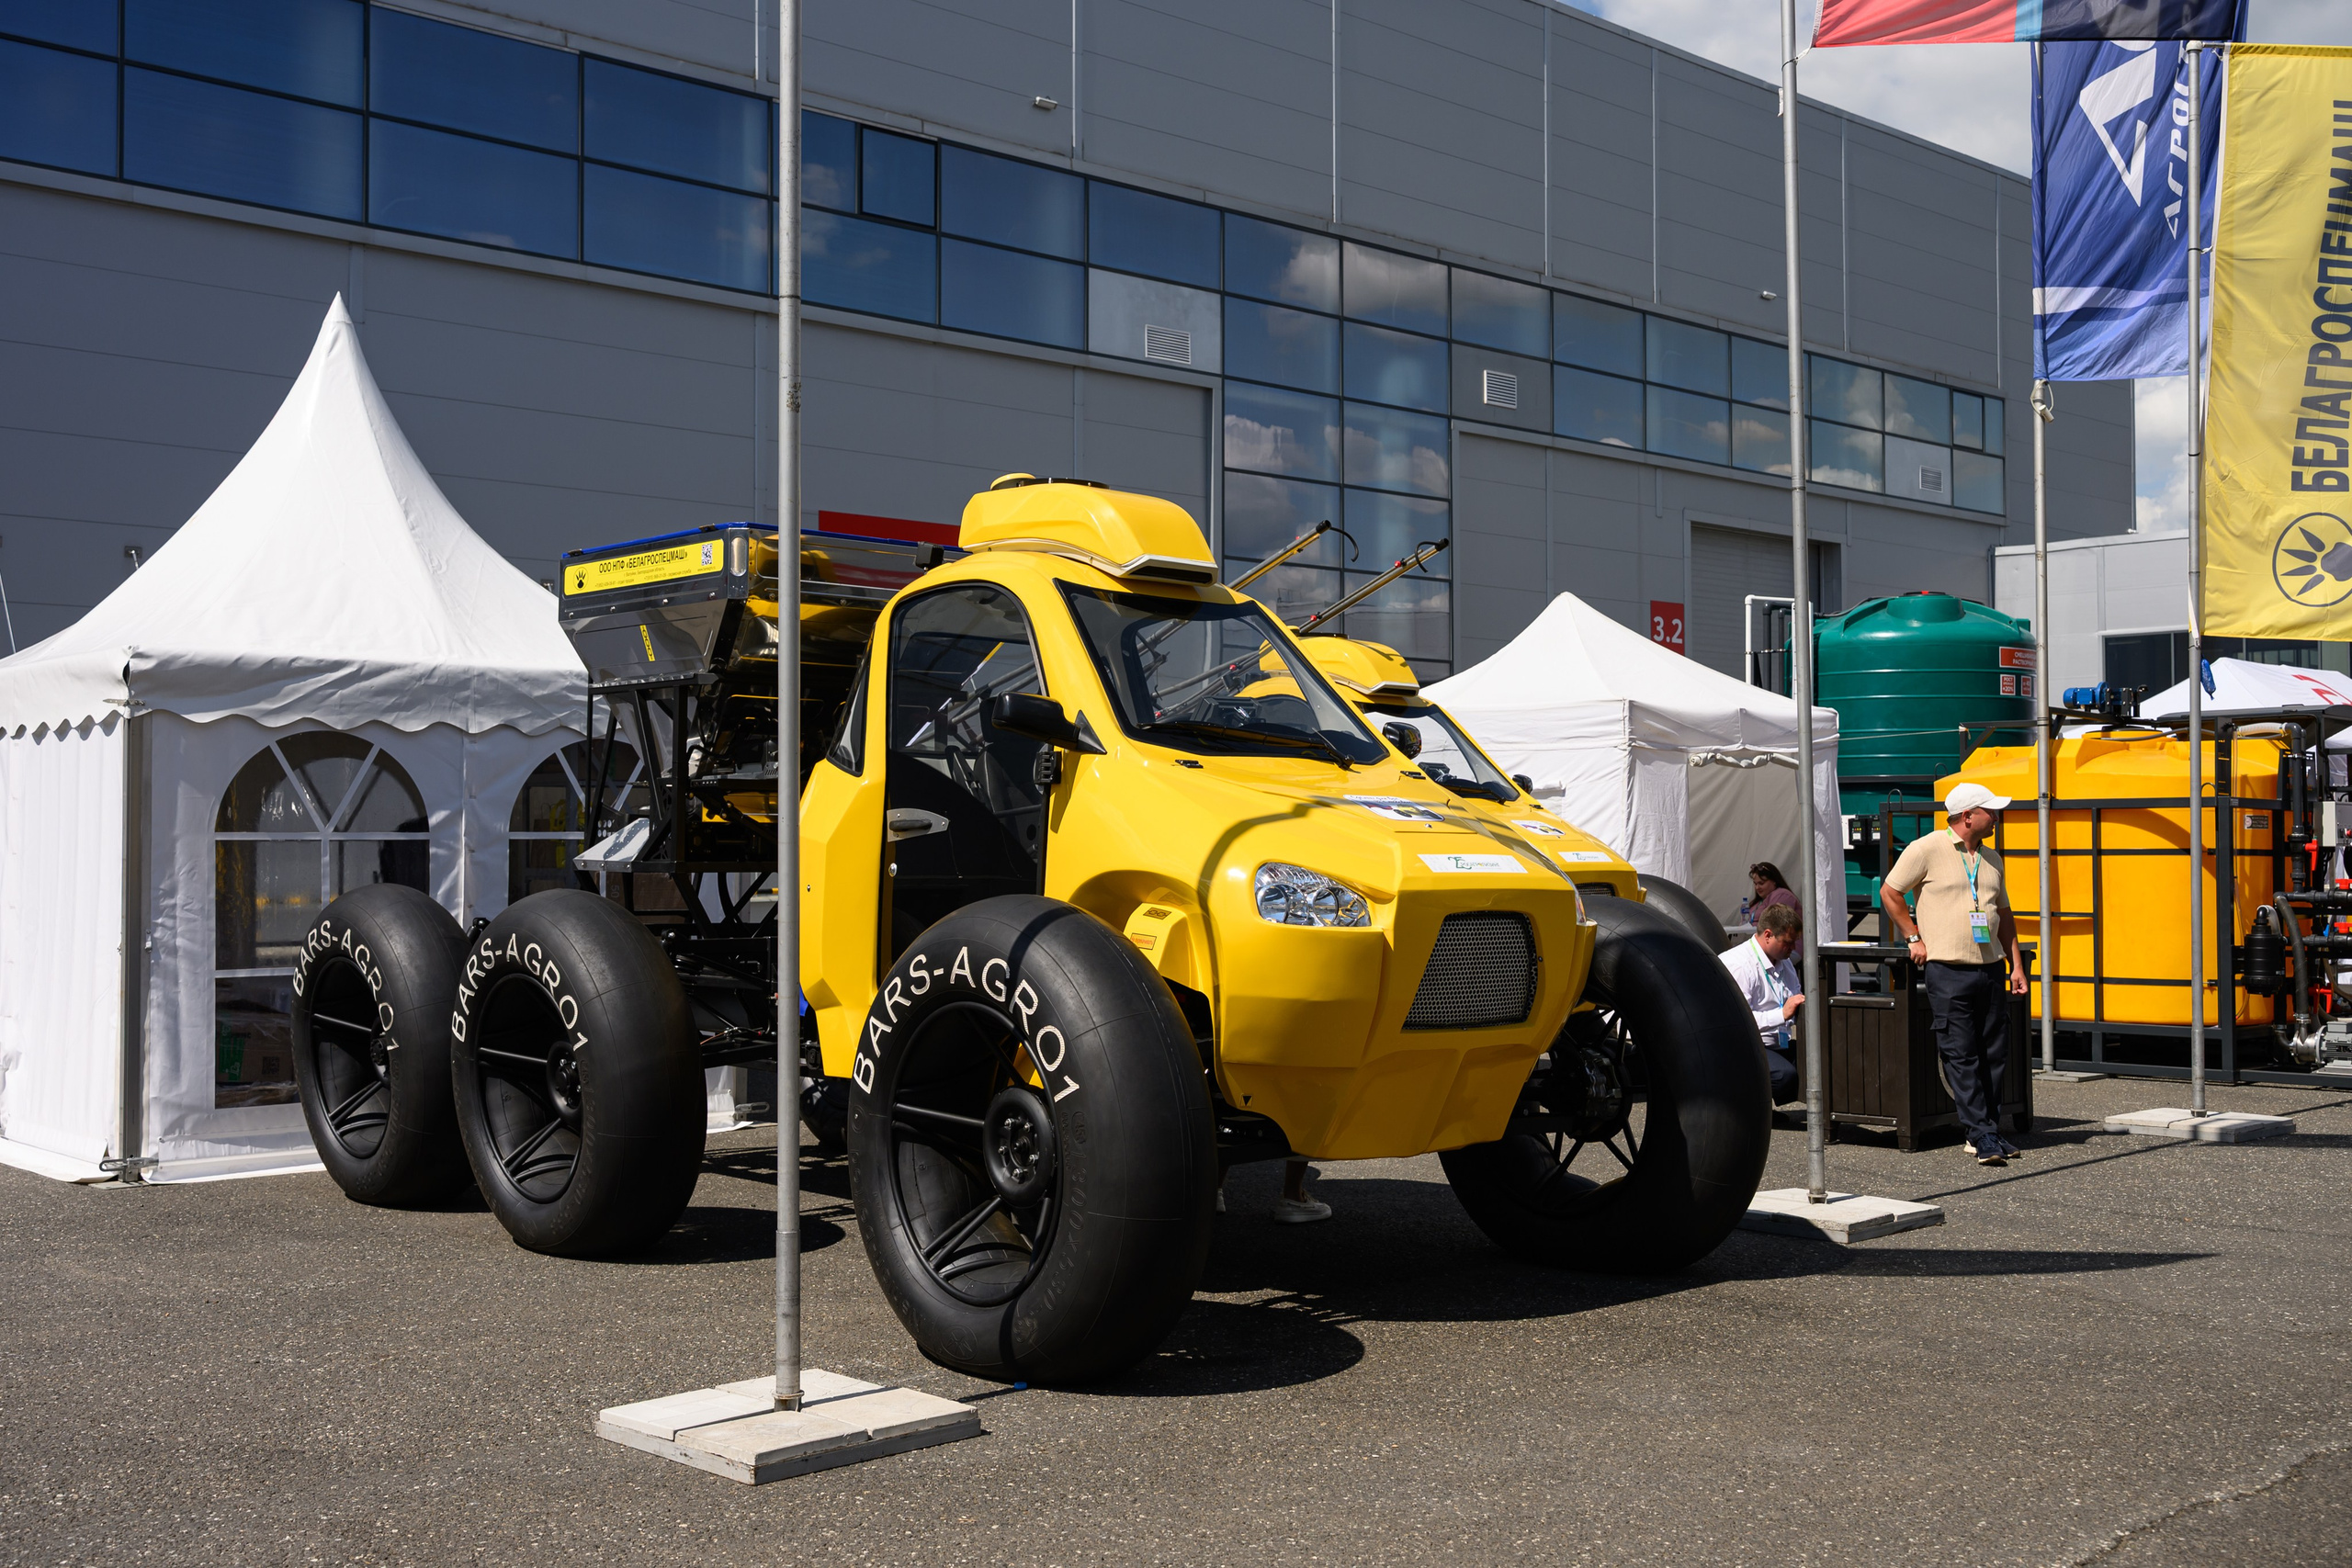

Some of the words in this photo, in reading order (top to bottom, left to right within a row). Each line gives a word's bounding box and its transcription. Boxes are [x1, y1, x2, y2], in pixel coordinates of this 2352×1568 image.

[598, 562, 612, 574] ООО
[612, 559, 626, 571] НПФ
[626, 549, 688, 569] «БЕЛАГРОСПЕЦМАШ»
[1653, 615, 1683, 644] 3.2
[293, 919, 400, 1051] BARS-AGRO1
[451, 932, 589, 1052] BARS-AGRO1
[854, 946, 1080, 1102] BARS-AGRO1
